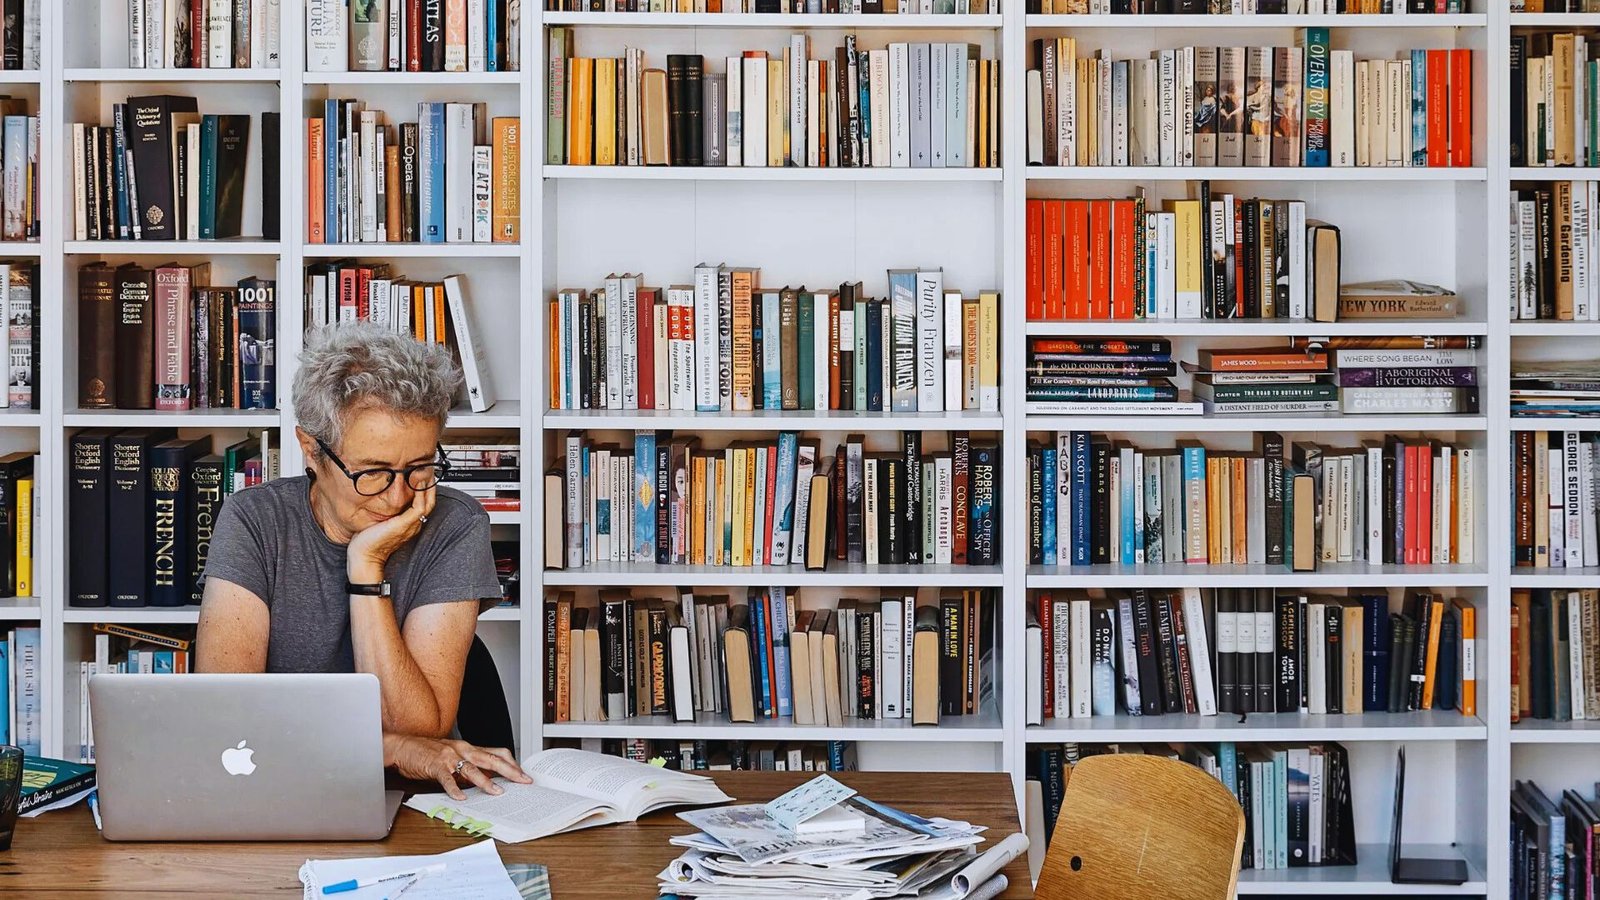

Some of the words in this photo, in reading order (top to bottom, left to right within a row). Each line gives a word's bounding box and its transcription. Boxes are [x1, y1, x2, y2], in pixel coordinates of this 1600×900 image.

[390, 11, 398, 37] TREES
[555, 57, 563, 86] KIRAN
[1045, 46, 1053, 89] WARLIGHT
[1164, 55, 1172, 75] Ann
[1309, 45, 1325, 117] OVERSTORY
[555, 91, 563, 119] DESAI
[1164, 78, 1172, 116] Patchett
[1185, 86, 1193, 109] TRUE
[115, 112, 123, 148] Eucalyptus
[137, 119, 160, 127] Quotations
[1062, 110, 1072, 142] MEAT
[1185, 112, 1193, 136] GRIT
[1316, 118, 1324, 147] RICHARD
[1308, 124, 1316, 152] POWERS
[403, 146, 415, 181] Opera
[508, 146, 516, 185] HISTORIC
[508, 188, 516, 209] SITES
[1215, 210, 1223, 243] HOME
[1561, 225, 1572, 282] Gardening
[157, 274, 189, 283] Oxford
[167, 289, 177, 326] Phrase
[238, 288, 273, 302] 1001
[703, 303, 709, 311] OF
[720, 275, 730, 336] RICHARD
[733, 278, 750, 318] CANADA
[921, 279, 937, 322] Purity
[1369, 300, 1407, 312] YORK
[671, 308, 680, 337] FORD
[896, 295, 913, 344] JONATHAN
[968, 306, 976, 318] THE
[167, 329, 177, 349] and
[735, 325, 750, 368] RICHARD
[968, 320, 976, 346] WOMEN'S
[167, 352, 177, 381] Fable
[896, 348, 913, 390] FRANZEN
[924, 328, 938, 387] Franzen
[968, 348, 976, 365] ROOM
[1344, 355, 1374, 363] WHERE
[720, 361, 730, 397] FORD
[1386, 369, 1450, 377] ABORIGINAL
[1386, 377, 1454, 386] VICTORIANS
[672, 384, 680, 394] Day
[1088, 388, 1138, 398] LANDPRINTS
[75, 457, 100, 465] English
[570, 445, 578, 469] Helen
[1567, 433, 1578, 472] GEORGE
[192, 472, 221, 480] Oxford
[570, 472, 578, 500] Garner
[975, 465, 983, 506] HARRIS
[983, 465, 992, 506] ROBERT
[1033, 470, 1041, 492] tenth
[1097, 451, 1105, 494] Benang
[1032, 495, 1042, 504] of
[1568, 477, 1578, 516] SEDDON
[957, 486, 966, 539] CONCLAVE
[1033, 506, 1041, 548] december
[939, 507, 949, 548] Archangel
[983, 519, 991, 558] OFFICER
[155, 499, 174, 587] FRENCH
[974, 534, 983, 551] SPY
[1136, 589, 1149, 628] TEMPLE
[547, 611, 555, 642] POMPEII
[1159, 605, 1171, 644] TEMPLE
[25, 645, 33, 666] THE
[1141, 631, 1150, 656] Truth
[25, 669, 33, 697] BUSH
[652, 642, 665, 706] CAPRICORNIA
[1312, 775, 1320, 802] YATES
